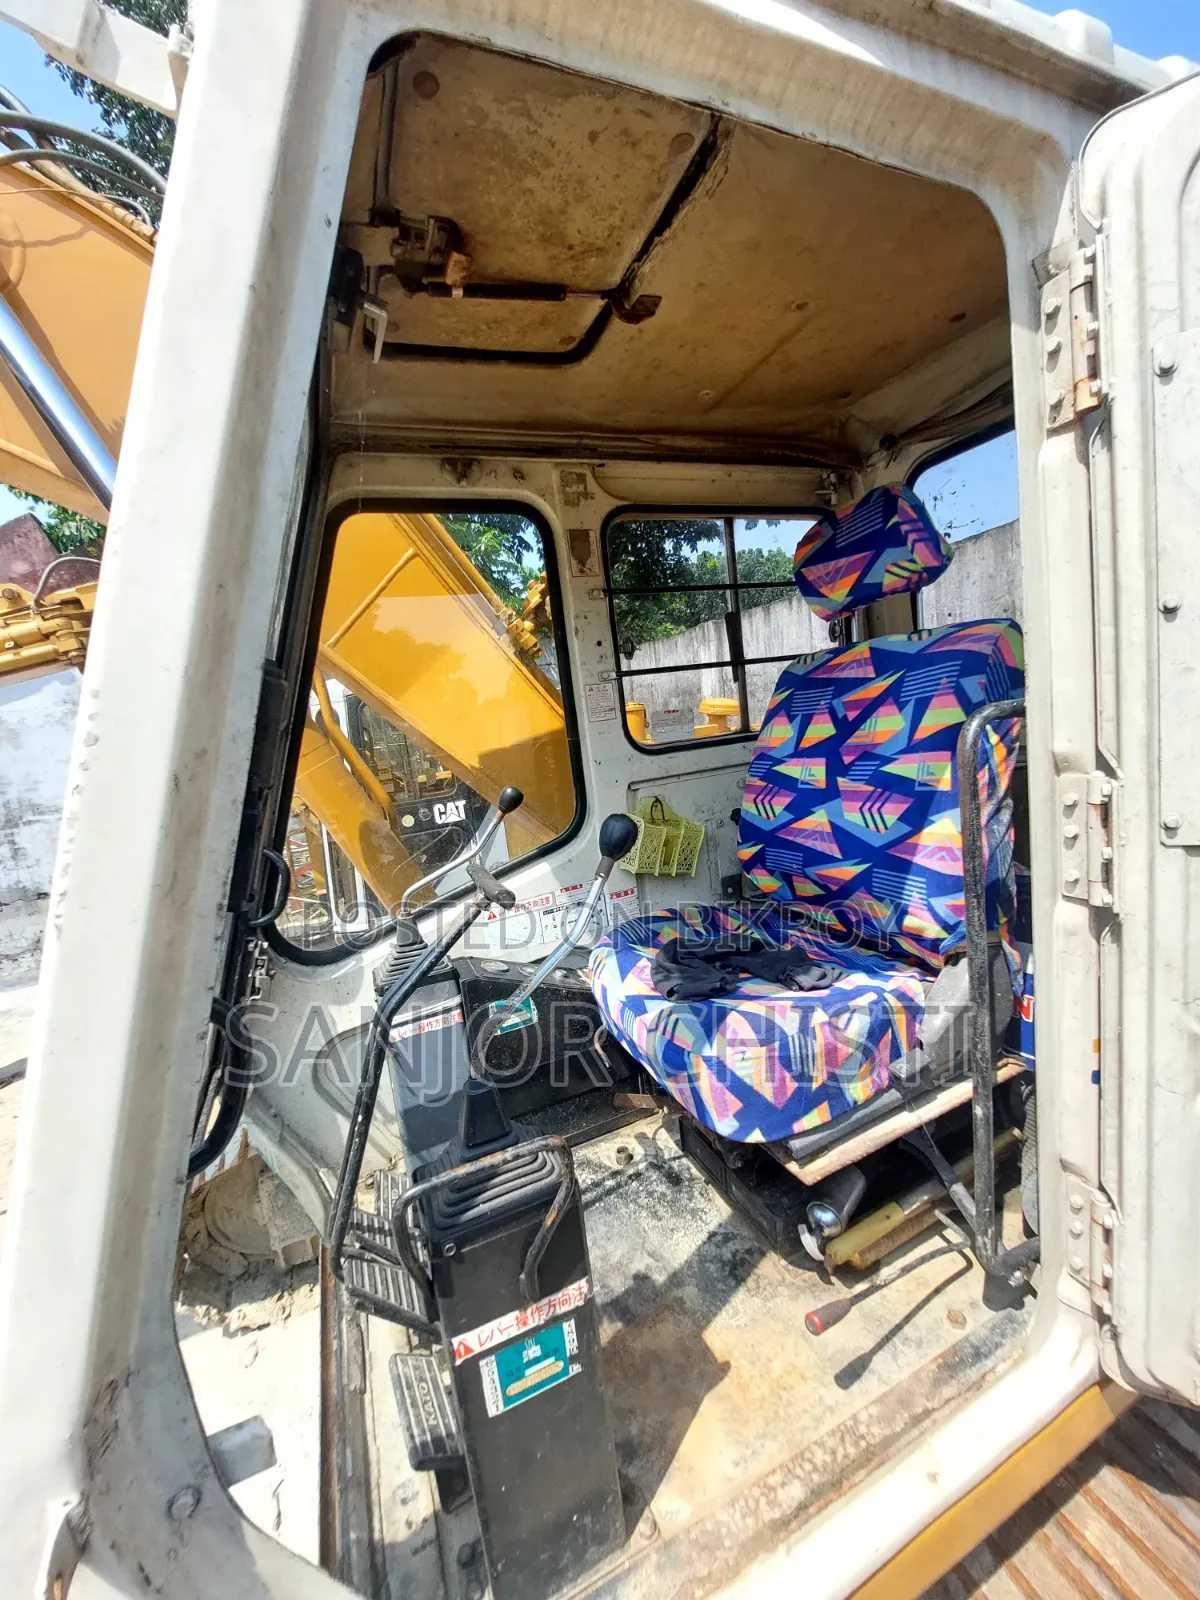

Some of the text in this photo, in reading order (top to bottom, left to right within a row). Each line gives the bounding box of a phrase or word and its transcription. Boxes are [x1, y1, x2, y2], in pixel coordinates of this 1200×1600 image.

[433, 799, 467, 824] CAT
[477, 1284, 588, 1347] レバー操作方向注
[418, 1382, 437, 1425] KATO
